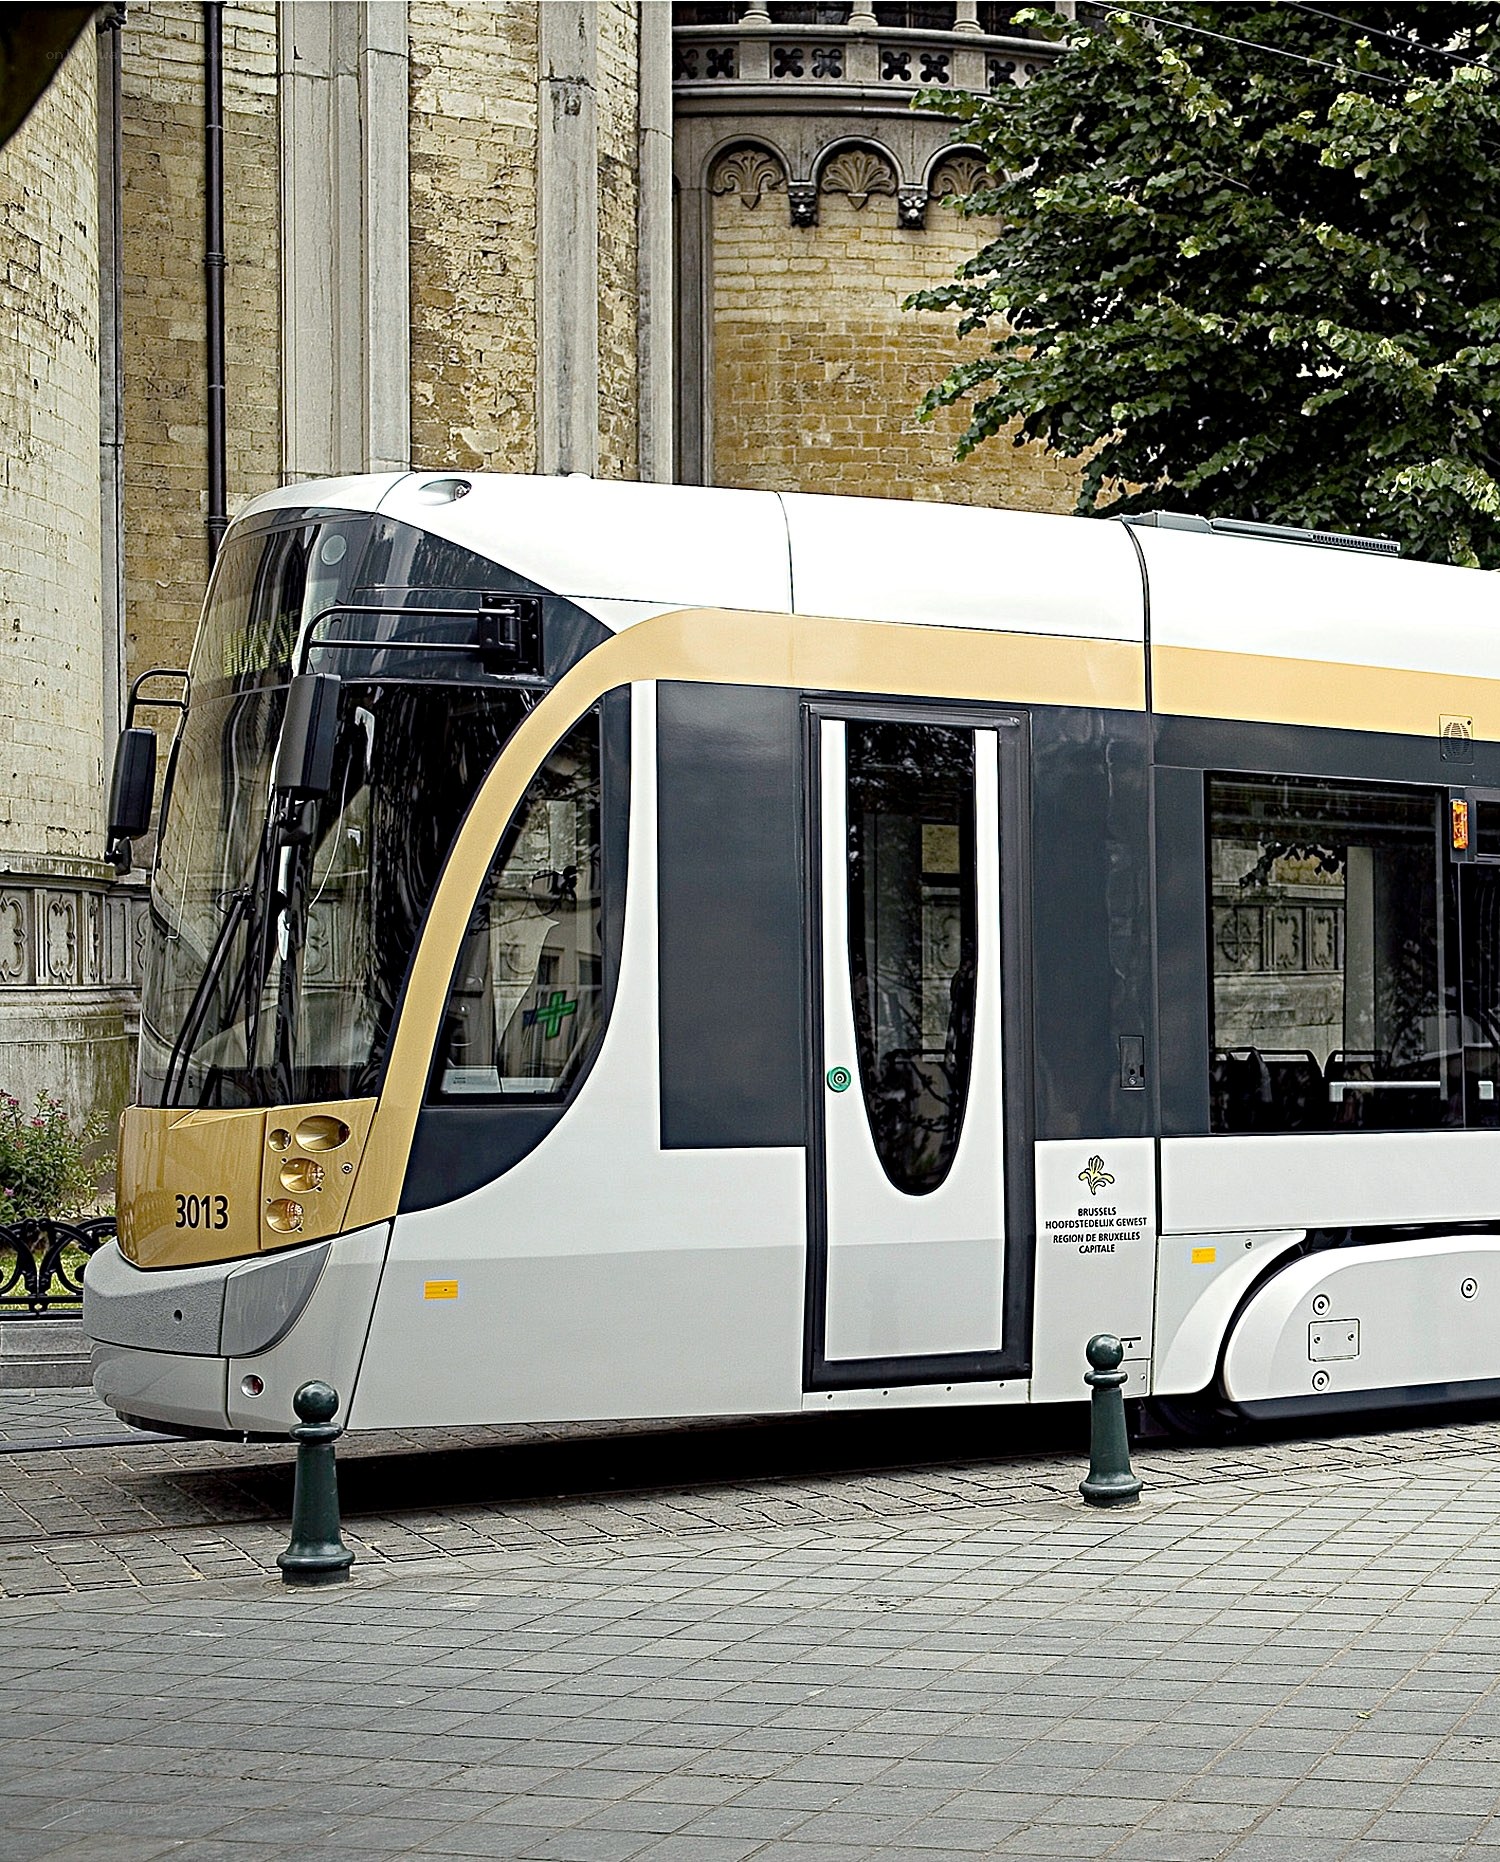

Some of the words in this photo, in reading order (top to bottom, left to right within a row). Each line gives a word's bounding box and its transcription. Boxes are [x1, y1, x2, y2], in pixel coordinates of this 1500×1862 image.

[175, 1194, 229, 1230] 3013
[1077, 1207, 1117, 1217] BRUSSELS
[1045, 1218, 1115, 1229] HOOFDSTEDELIJK
[1116, 1217, 1148, 1227] GEWEST
[1052, 1234, 1084, 1244] REGION
[1085, 1233, 1097, 1242] DE
[1098, 1231, 1141, 1242] BRUXELLES
[1078, 1244, 1116, 1254] CAPITALE
